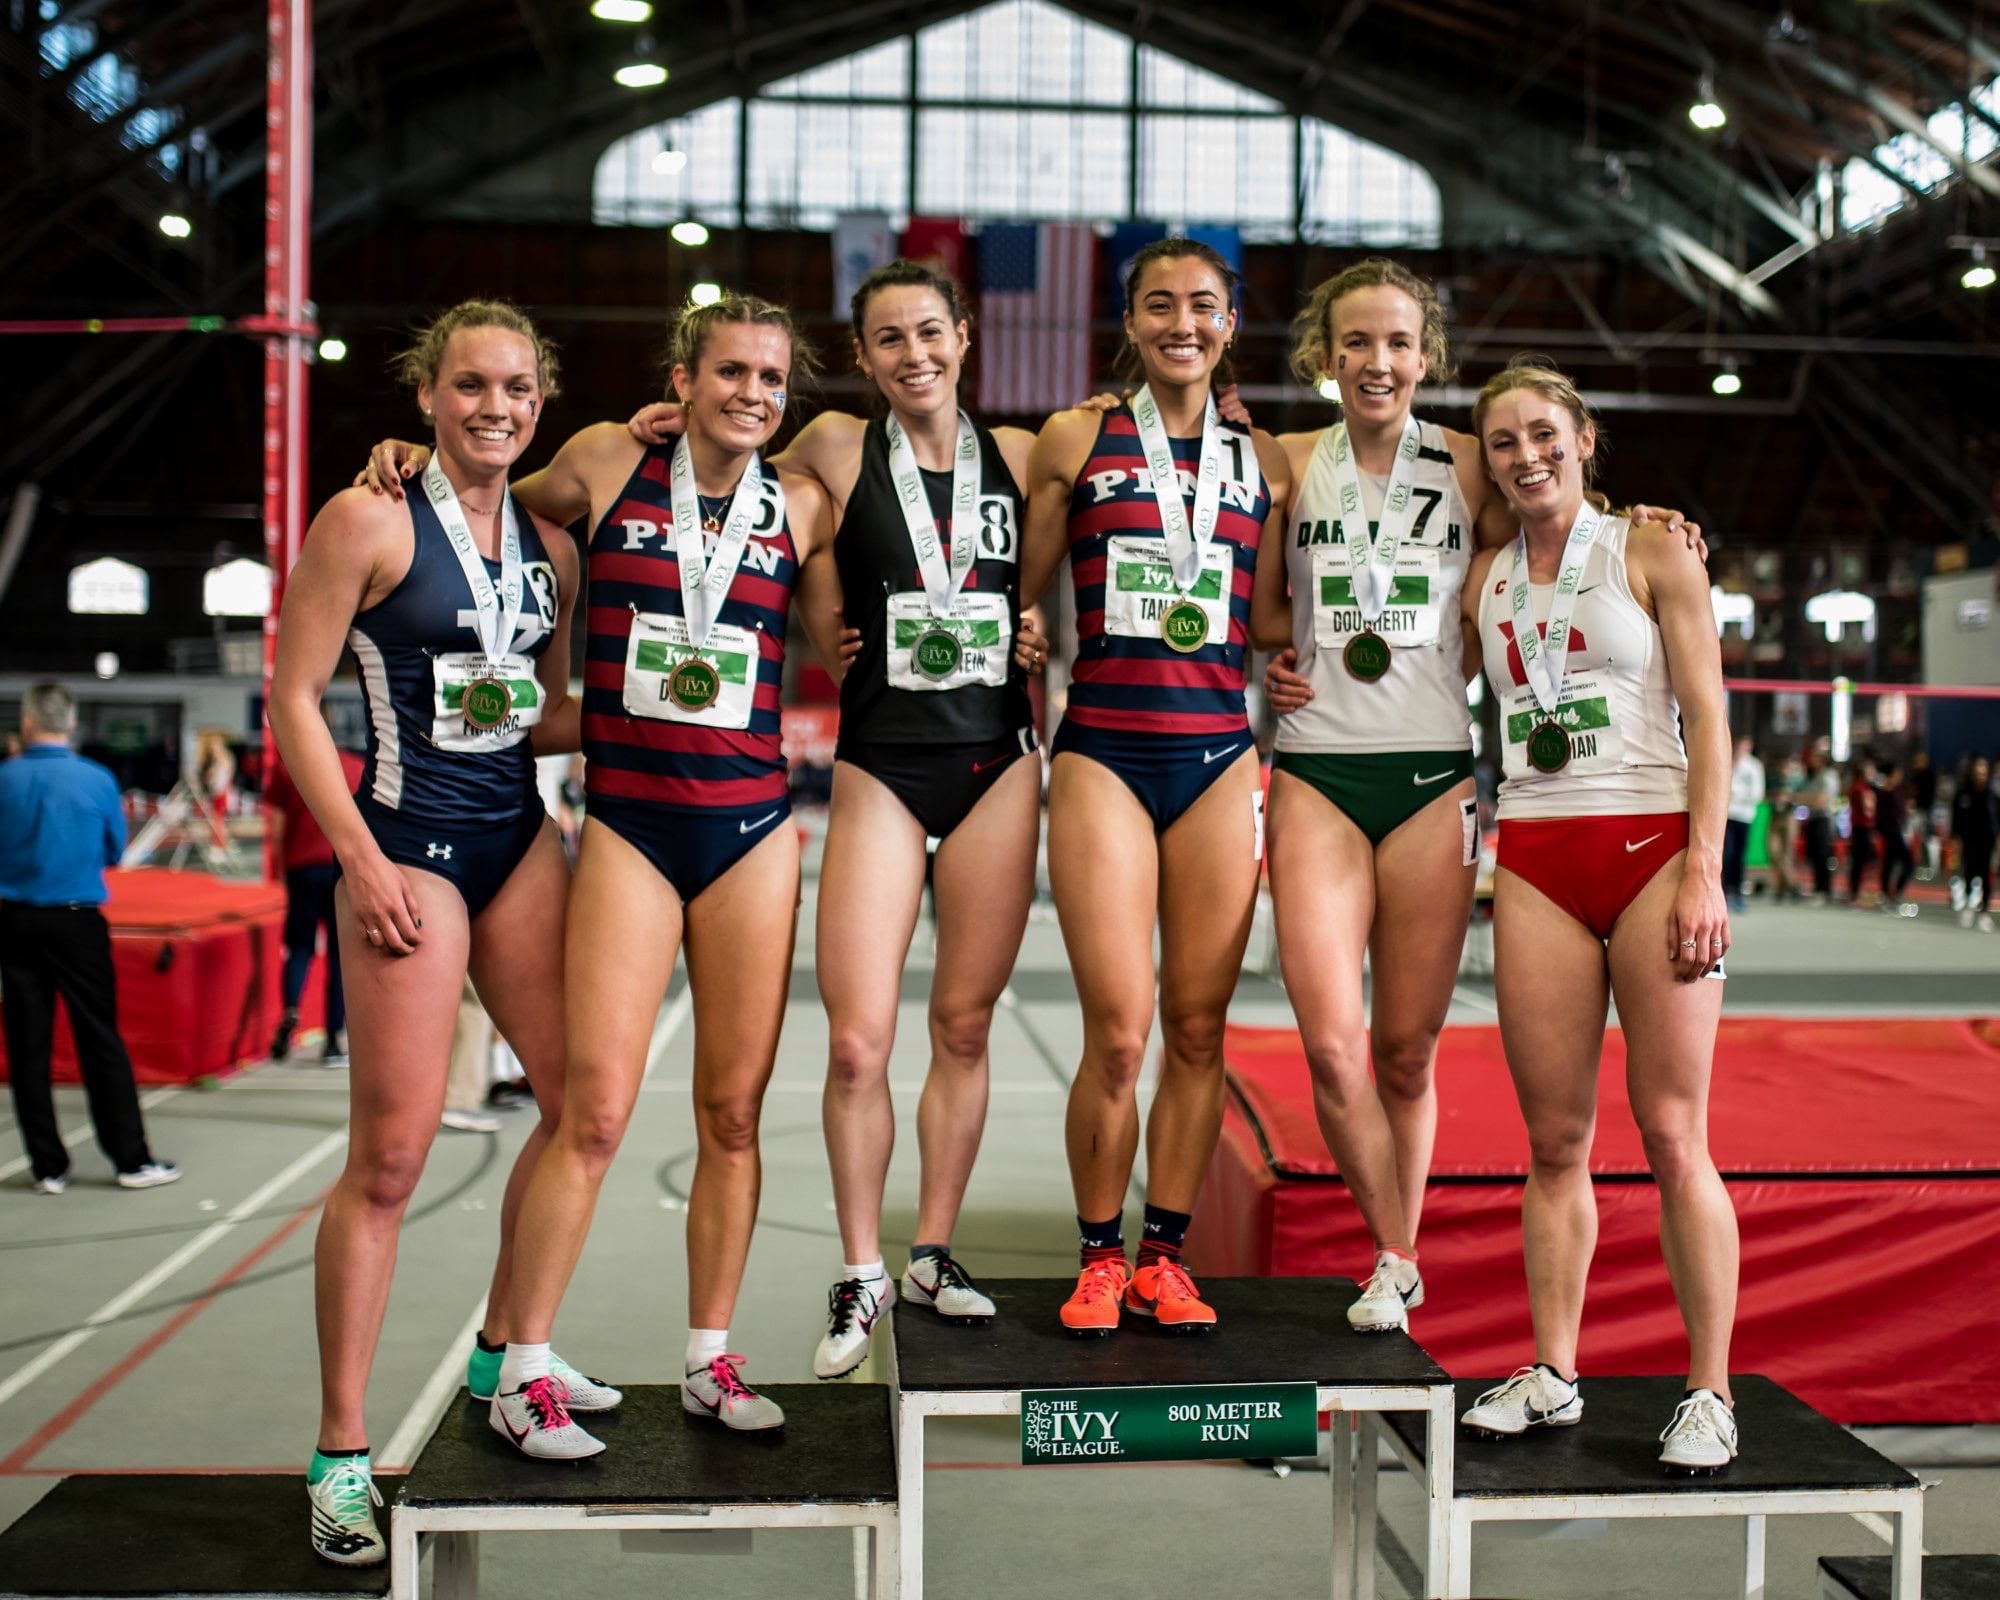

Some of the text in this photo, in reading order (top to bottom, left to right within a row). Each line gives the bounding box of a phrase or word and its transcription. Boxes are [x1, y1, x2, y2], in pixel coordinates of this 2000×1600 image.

[1141, 407, 1157, 430] IVY
[963, 434, 973, 454] IVY
[1405, 434, 1418, 455] IVY
[675, 454, 686, 477] IVY
[1156, 457, 1170, 480] IVY
[1221, 437, 1244, 483] 1
[431, 478, 448, 501] IVY
[904, 481, 920, 504] IVY
[960, 482, 971, 504] IVY
[1393, 481, 1407, 504] IVY
[1344, 491, 1357, 513] IVY
[1410, 488, 1443, 539] 7
[680, 509, 694, 533] IVY
[732, 511, 746, 536] IVY
[1169, 510, 1184, 534] IVY
[1578, 519, 1593, 538] IVY
[456, 532, 471, 553] IVY
[921, 535, 936, 559] IVY
[957, 536, 968, 559] IVY
[1381, 534, 1394, 558] IVY
[1354, 543, 1367, 566] IVY
[688, 566, 701, 592] IVY
[713, 563, 727, 587] IVY
[1563, 565, 1577, 587] IVY
[479, 585, 493, 609] IVY
[531, 566, 557, 624] 3
[1495, 580, 1507, 595] C
[1516, 590, 1526, 611] IVY
[1177, 620, 1200, 631] IVY
[1552, 617, 1564, 641] IVY
[929, 649, 953, 660] IVY
[1525, 639, 1539, 661] IVY
[686, 680, 710, 692] IVY
[1052, 1401, 1078, 1411] THE
[1168, 1401, 1282, 1422] 800 METER
[1051, 1411, 1120, 1441] IVY
[1201, 1424, 1250, 1442] RUN
